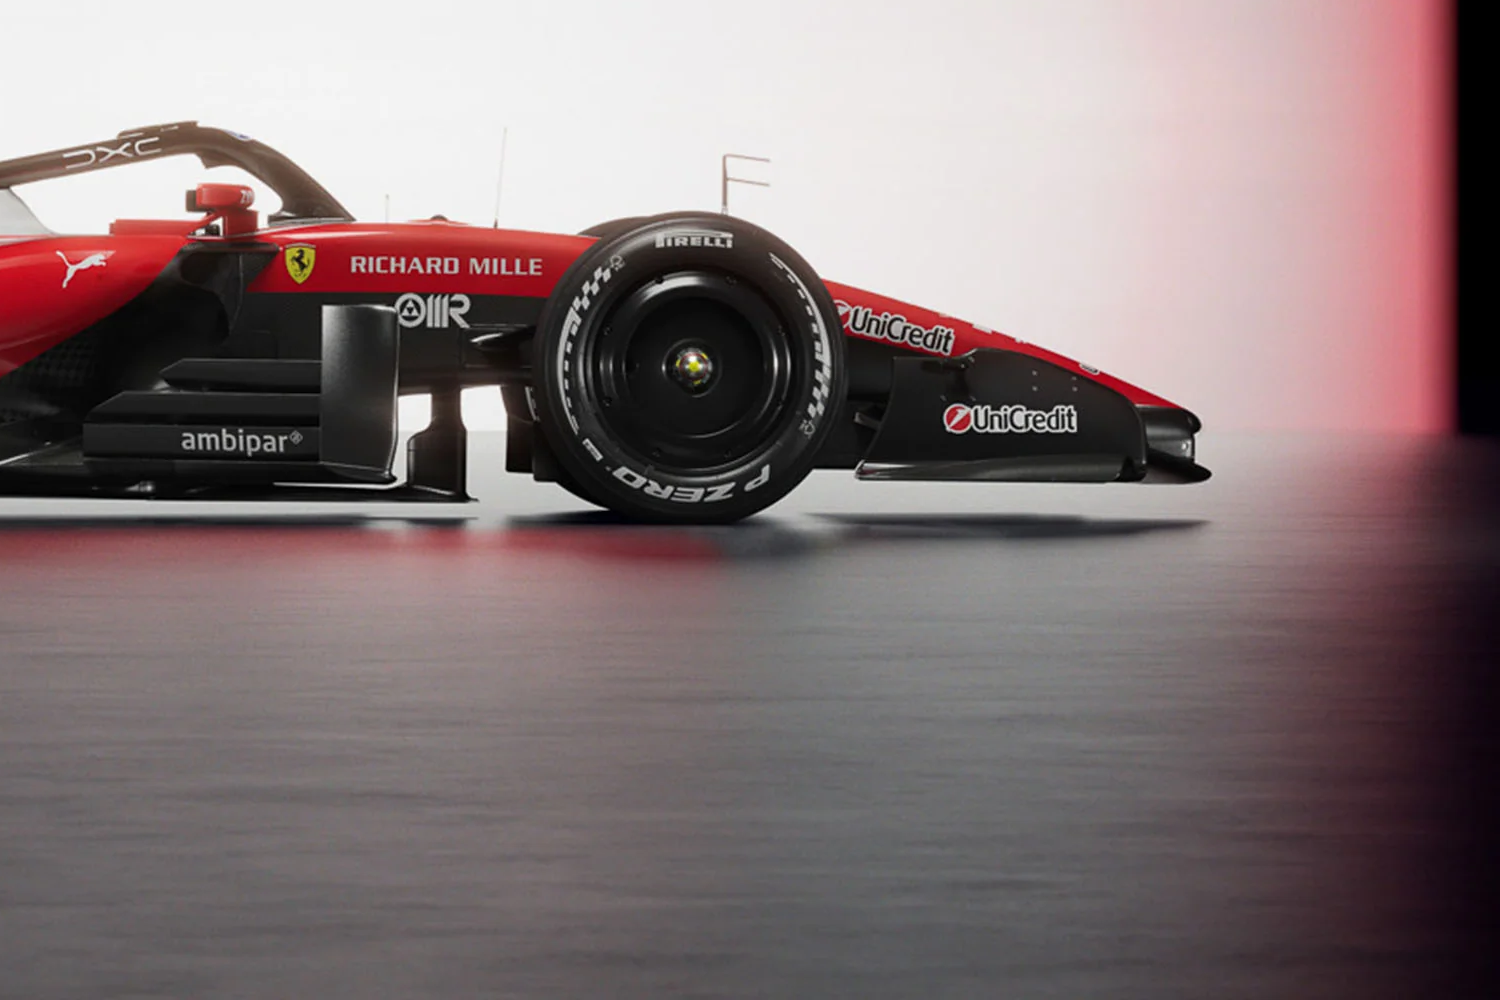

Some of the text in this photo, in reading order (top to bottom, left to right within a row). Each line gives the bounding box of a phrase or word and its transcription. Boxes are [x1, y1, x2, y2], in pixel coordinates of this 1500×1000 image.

[63, 136, 162, 169] DXC
[655, 229, 734, 248] PIRELLI
[350, 256, 543, 276] RICHARD MILLE
[850, 306, 954, 354] UniCredit
[971, 405, 1078, 432] UniCredit
[612, 463, 772, 503] P ZERO
